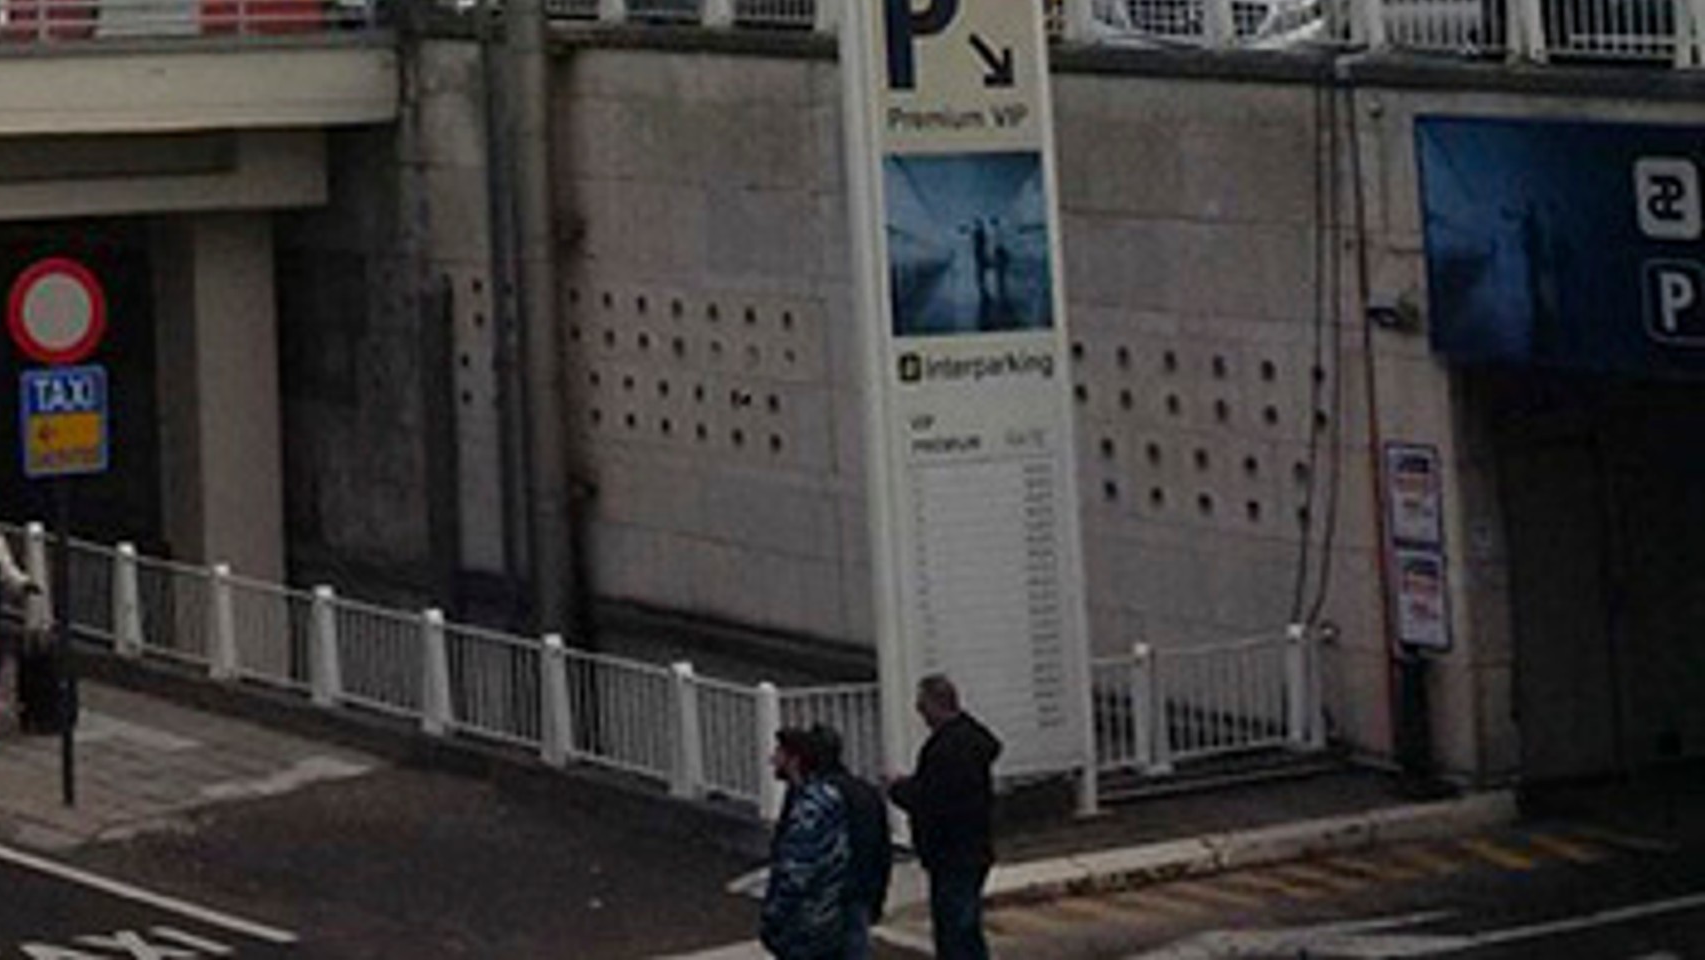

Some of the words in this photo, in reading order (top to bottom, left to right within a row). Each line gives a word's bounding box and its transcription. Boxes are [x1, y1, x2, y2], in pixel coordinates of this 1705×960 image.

[886, 106, 986, 130] Premium
[991, 103, 1029, 127] VIP
[1660, 272, 1694, 331] P
[34, 378, 94, 412] TAXI
